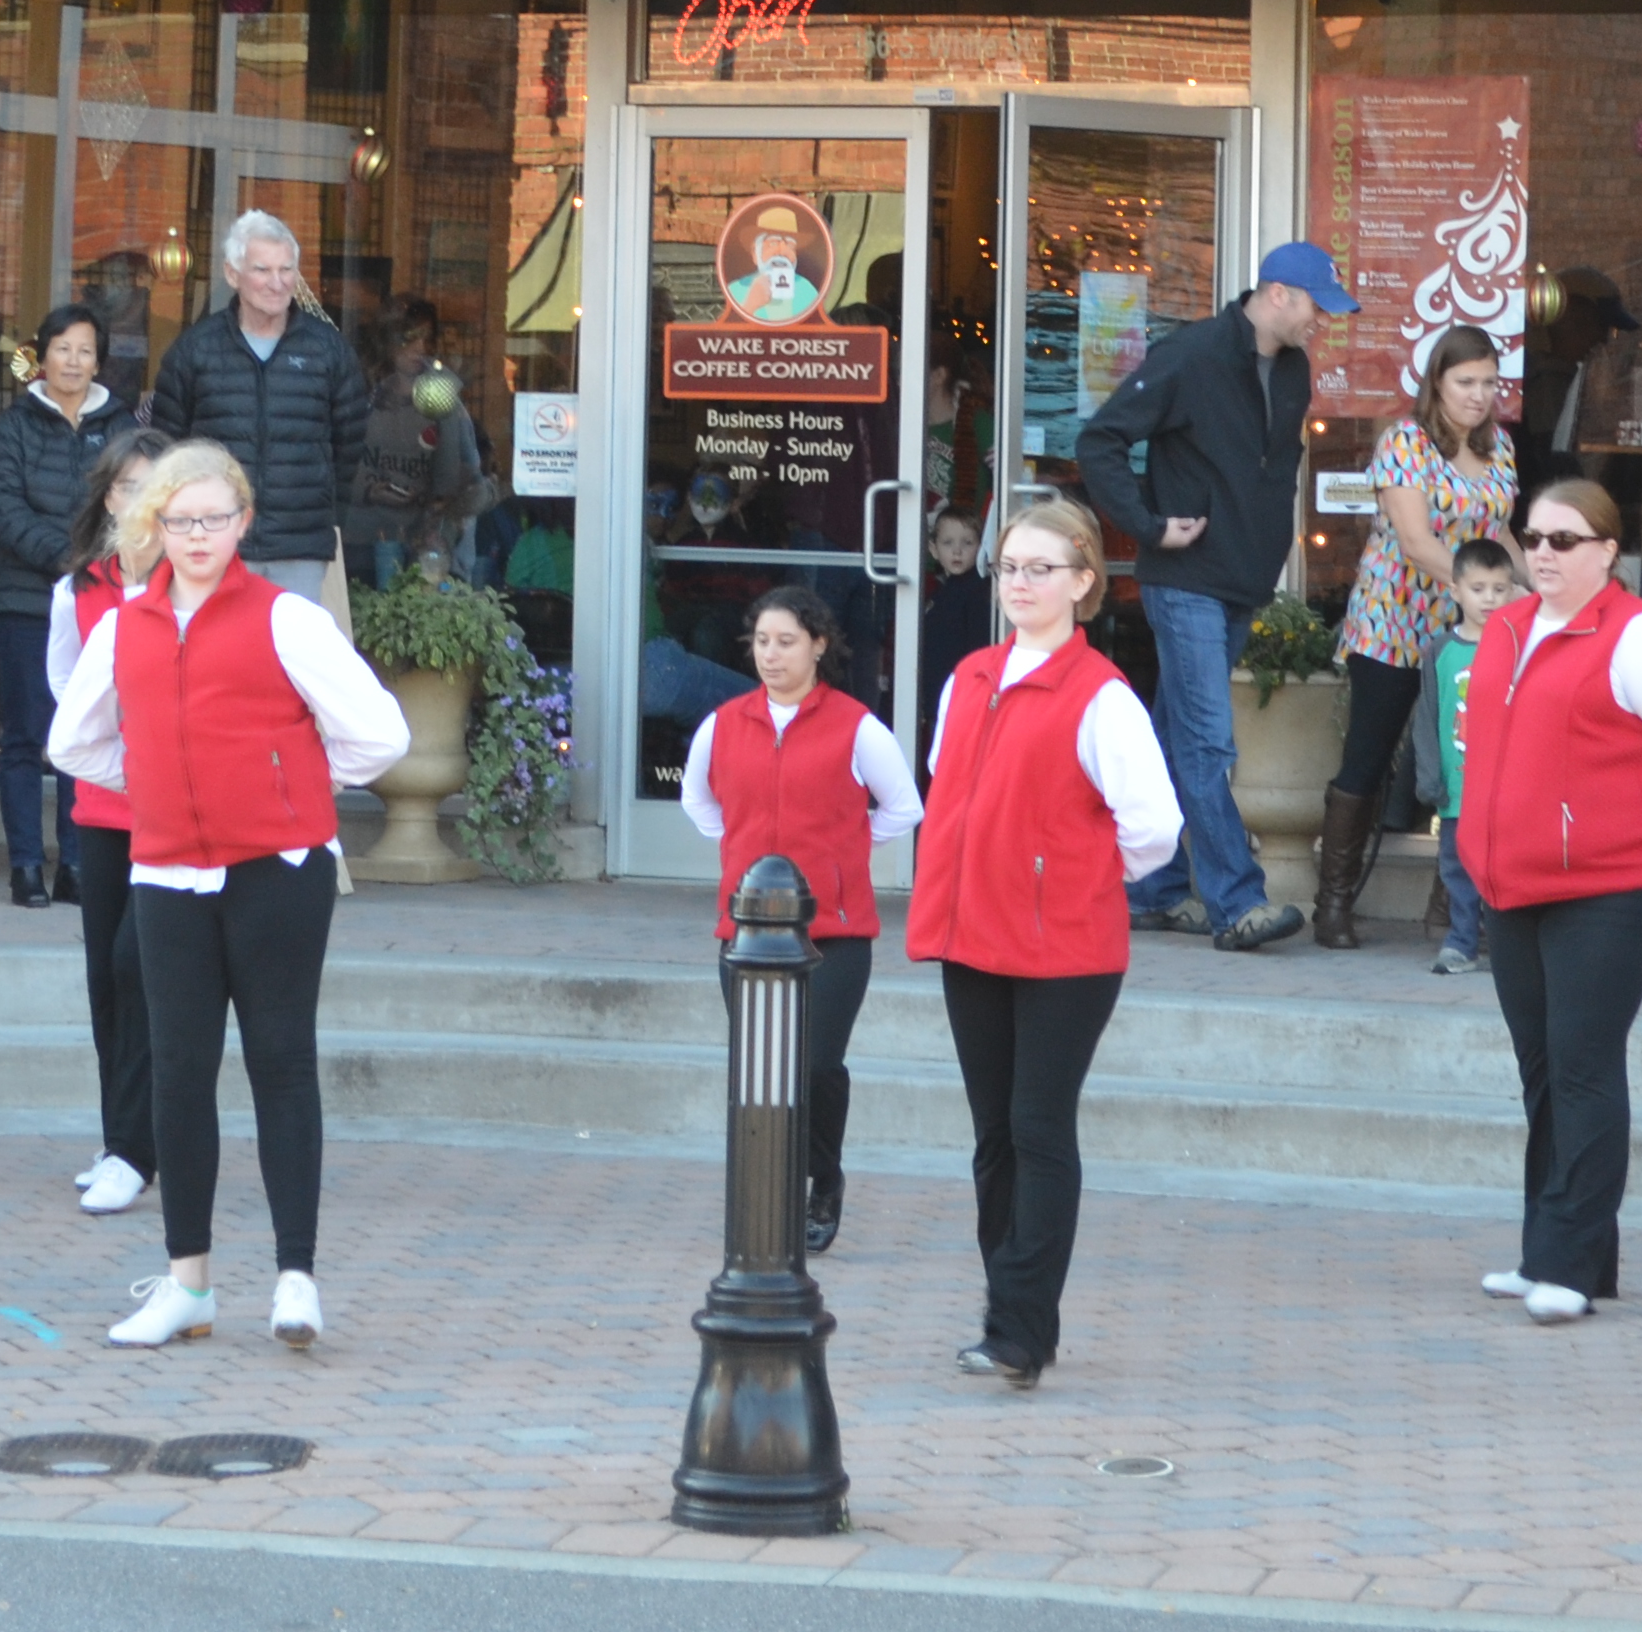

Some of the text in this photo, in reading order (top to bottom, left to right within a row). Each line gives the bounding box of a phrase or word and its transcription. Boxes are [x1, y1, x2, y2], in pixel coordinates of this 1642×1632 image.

[1331, 98, 1354, 222] season
[698, 337, 850, 357] WAKE FOREST
[672, 360, 875, 381] COFFEE COMPANY
[706, 408, 844, 431] Business Hours
[695, 434, 770, 459] Monday
[787, 437, 854, 462] Sunday
[728, 465, 757, 481] am
[778, 464, 830, 486] 10pm
